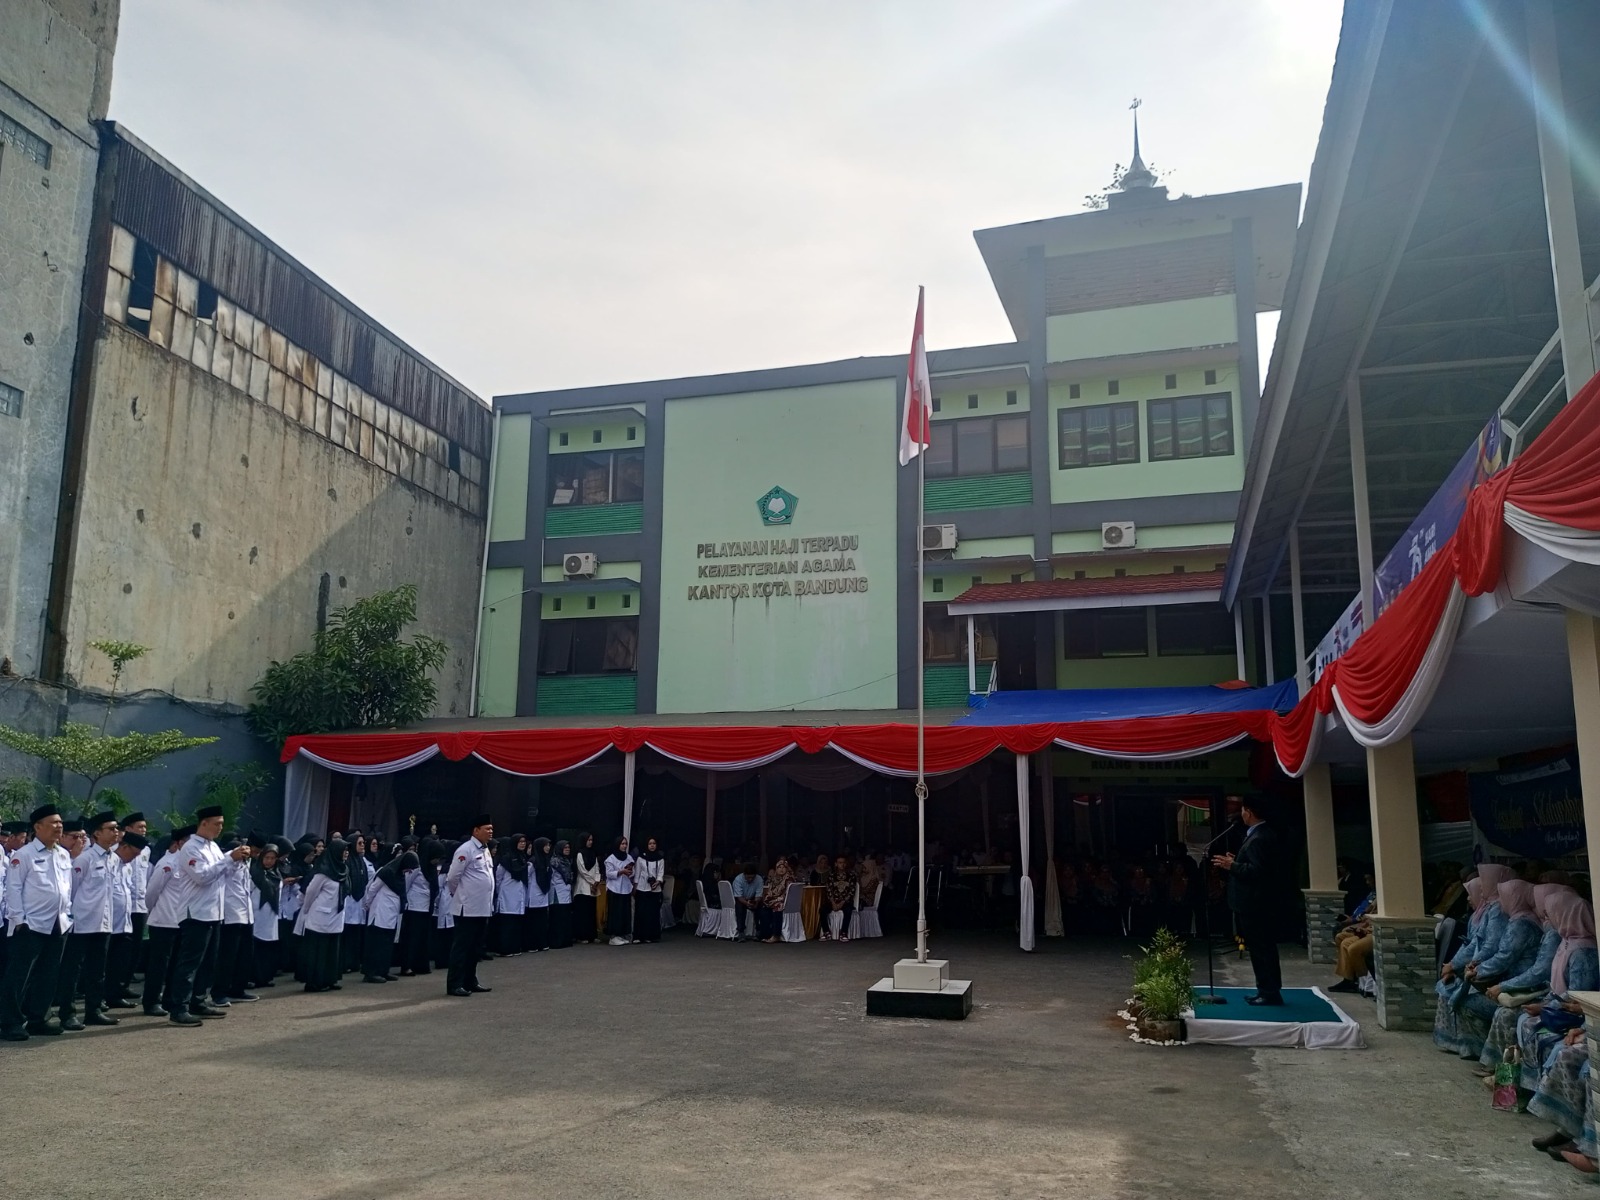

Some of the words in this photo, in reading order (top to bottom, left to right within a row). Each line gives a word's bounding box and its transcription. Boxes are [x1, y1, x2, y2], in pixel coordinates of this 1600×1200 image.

[697, 541, 768, 558] PELAYANAN
[770, 539, 799, 555] HAJI
[801, 535, 859, 554] TERPADU
[698, 561, 798, 578] KEMENTERIAN
[801, 558, 855, 574] AGAMA
[688, 582, 749, 601] KANTOR
[752, 581, 791, 599] KOTA
[794, 577, 868, 596] BANDUNG
[1091, 760, 1132, 770] RUANG
